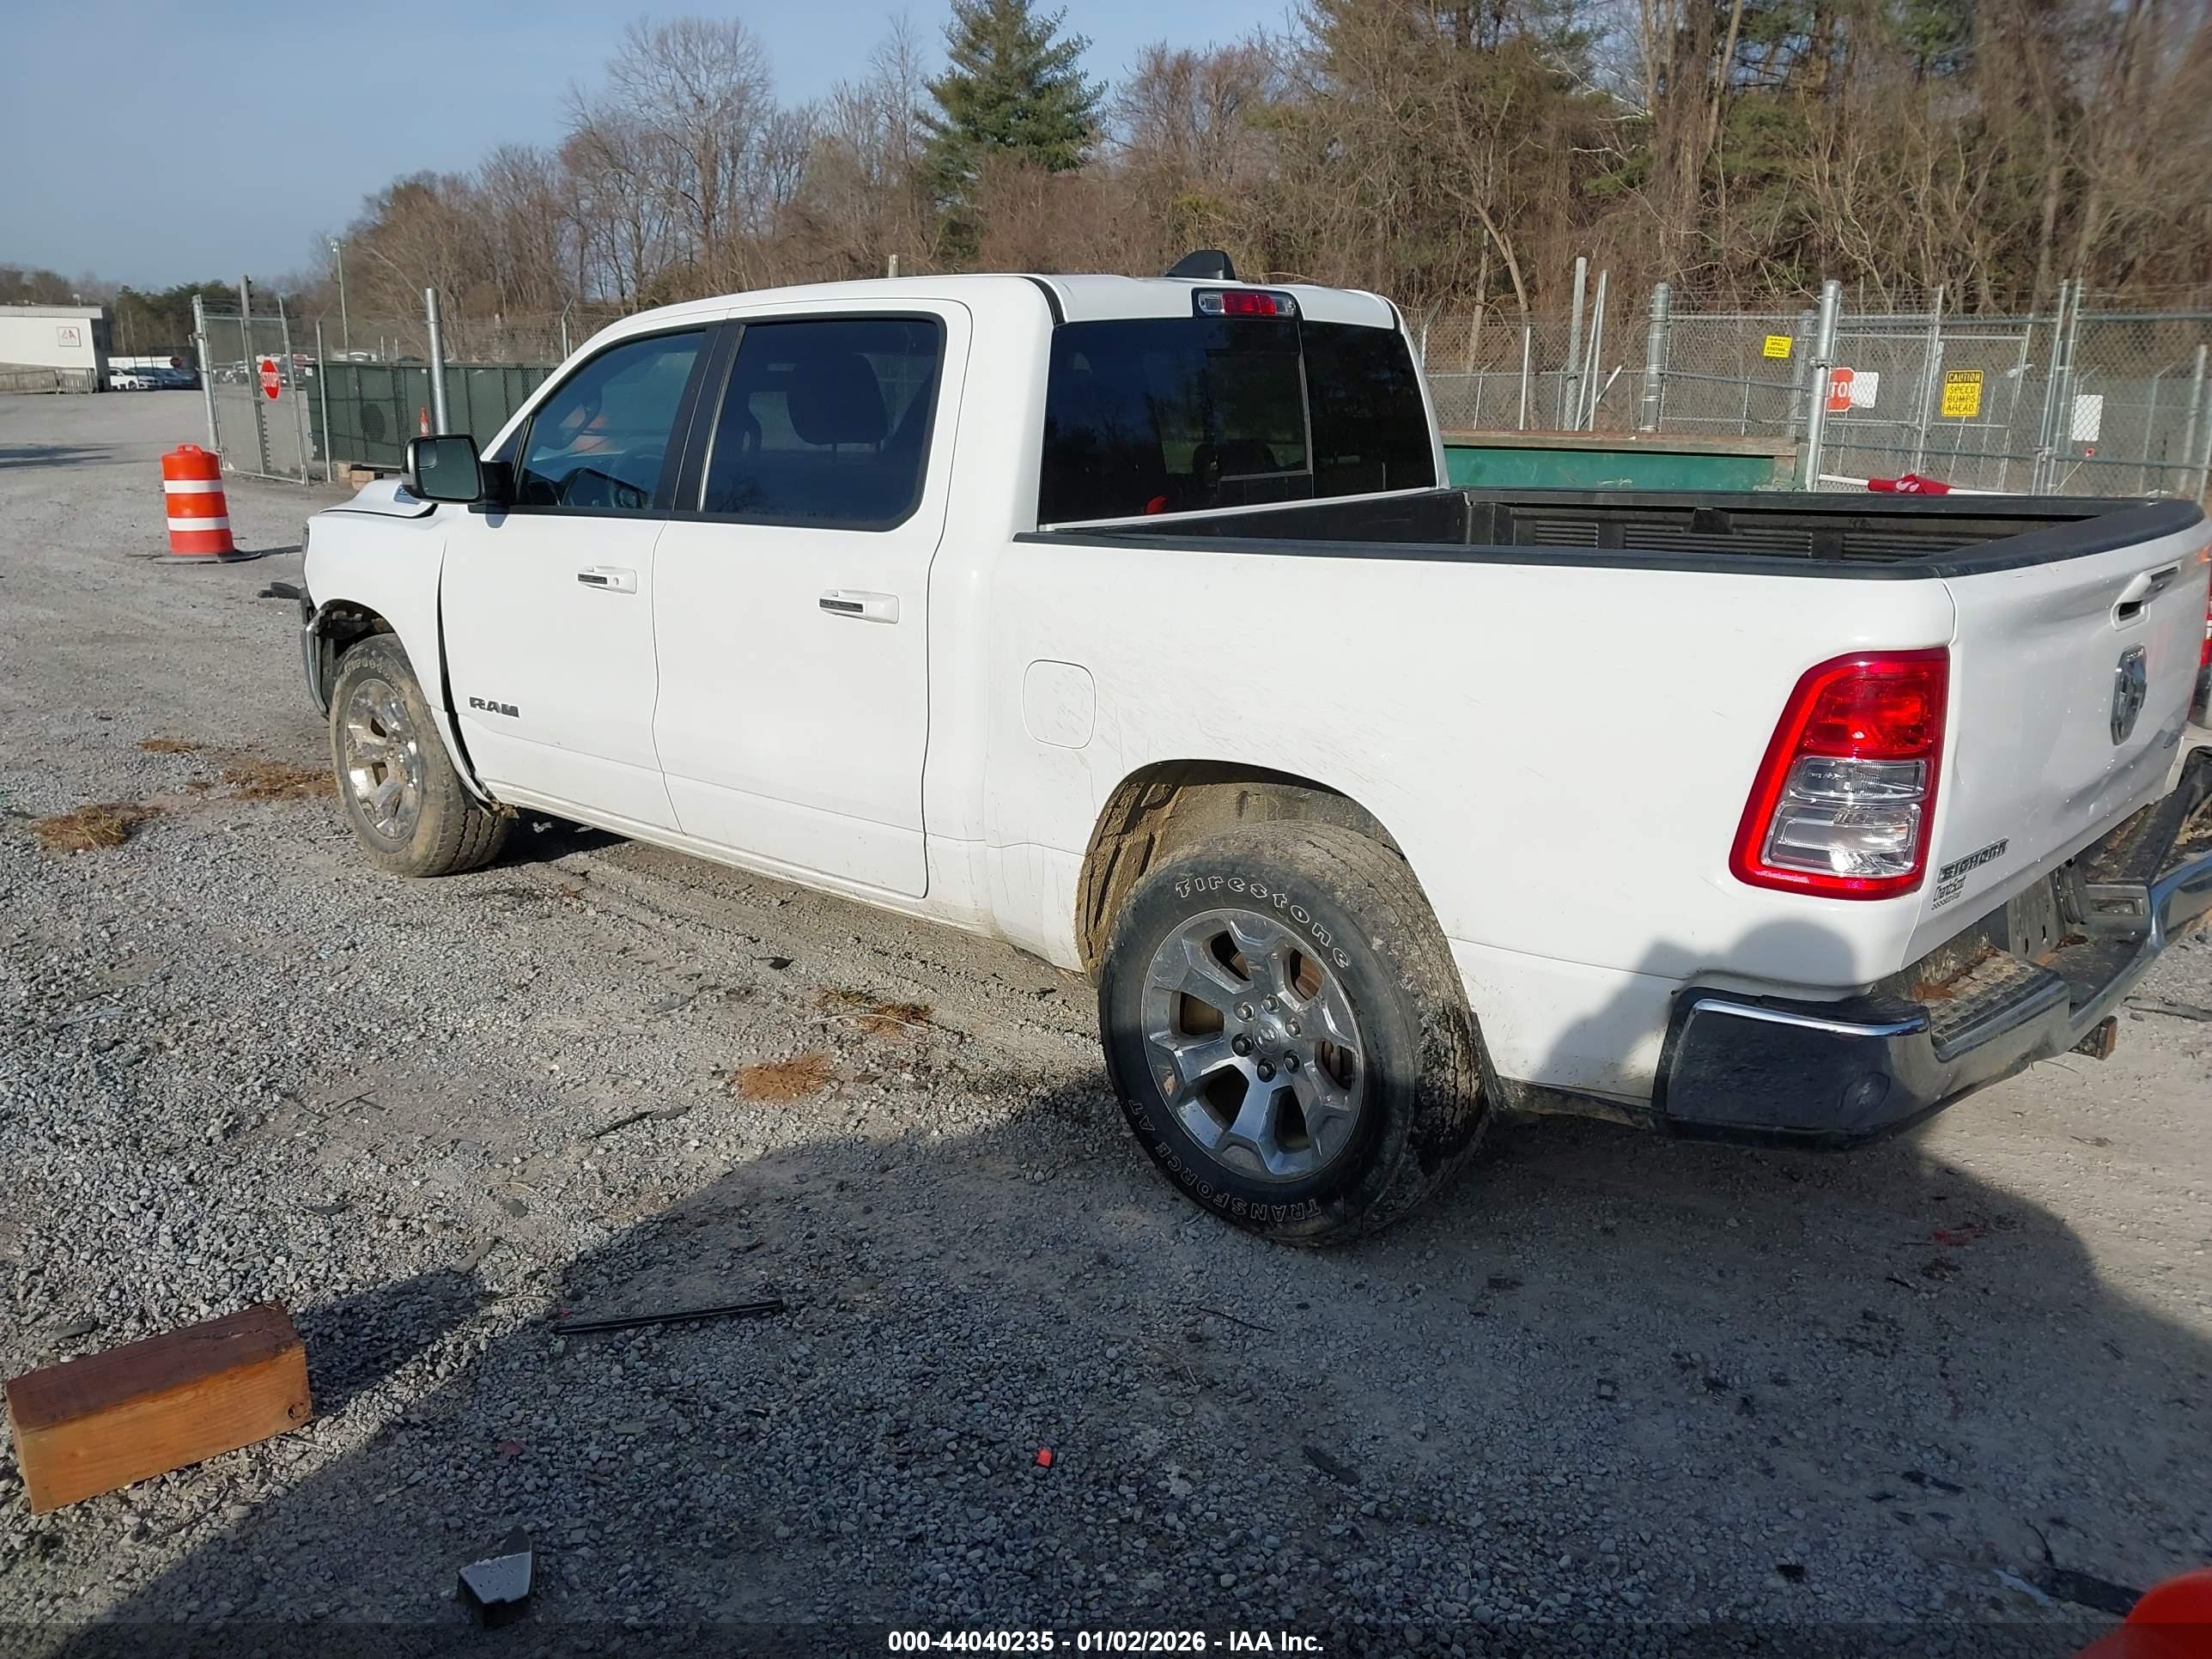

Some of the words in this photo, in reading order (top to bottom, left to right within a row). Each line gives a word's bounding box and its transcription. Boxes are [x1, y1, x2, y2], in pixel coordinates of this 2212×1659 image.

[1948, 373, 1980, 382] CAUTION
[1948, 386, 1976, 394] SPEED
[1947, 395, 1976, 404] BUMPS
[1947, 404, 1975, 412] AHEAD
[469, 696, 520, 718] RAM
[1176, 876, 1349, 968] Firestone
[1128, 1100, 1157, 1132] AT
[1155, 1141, 1322, 1223] TRANSFORCE
